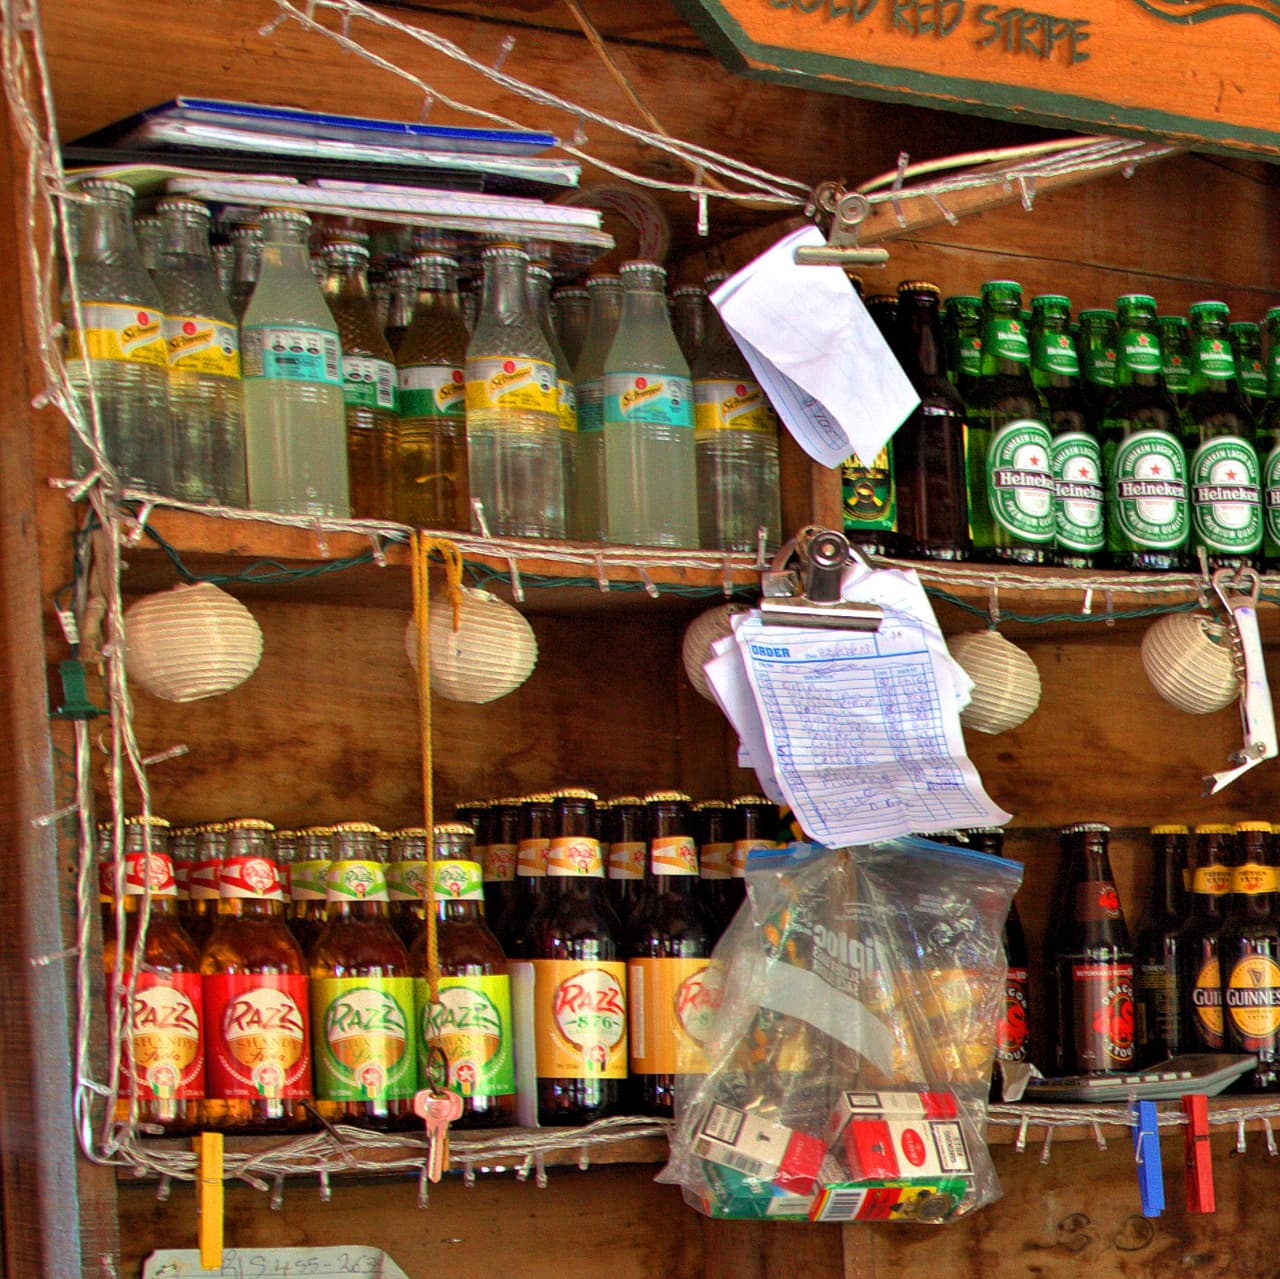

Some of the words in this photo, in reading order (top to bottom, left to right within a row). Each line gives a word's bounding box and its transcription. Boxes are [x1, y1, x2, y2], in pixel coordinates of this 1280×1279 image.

[975, 4, 1091, 64] STRIPE
[1122, 480, 1184, 500] Heineken
[1198, 488, 1258, 503] Heineken
[751, 644, 791, 660] ORDER
[228, 999, 305, 1033] RAZZ
[557, 985, 625, 1016] RAZZ
[330, 1002, 406, 1033] RAZZ
